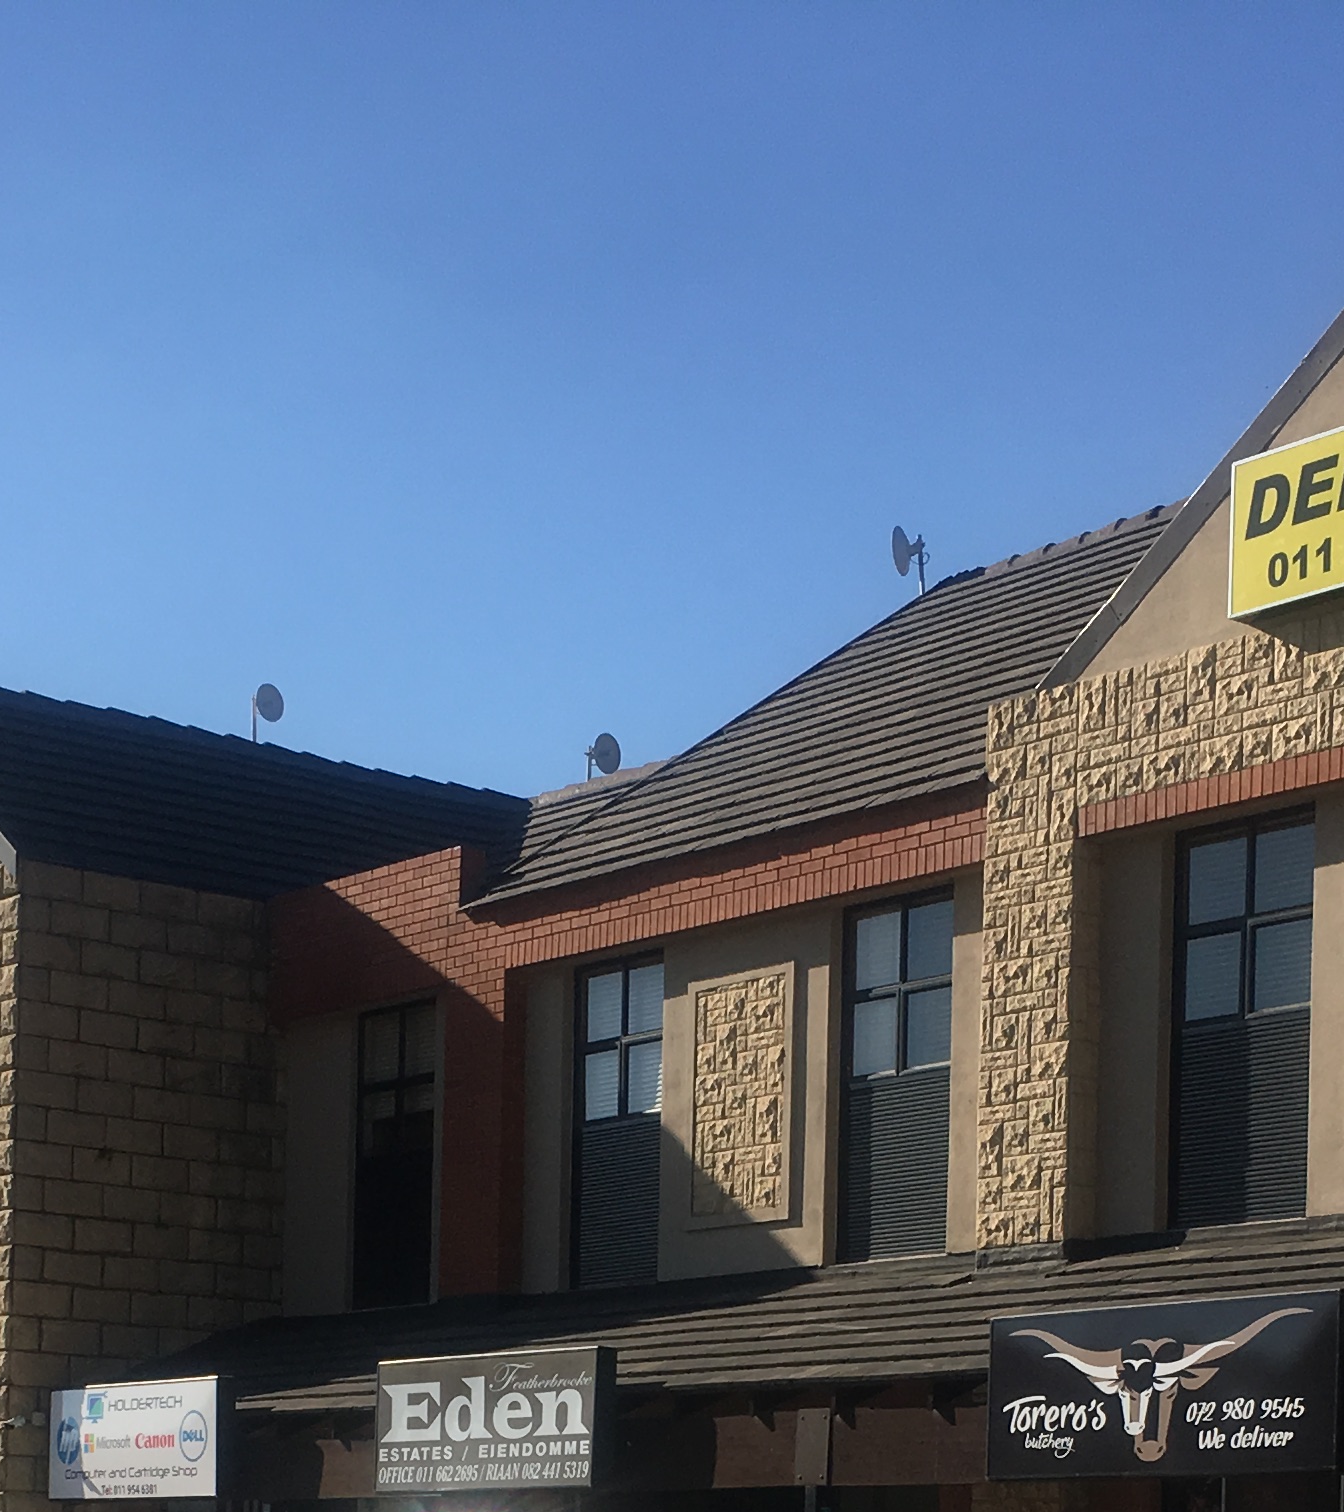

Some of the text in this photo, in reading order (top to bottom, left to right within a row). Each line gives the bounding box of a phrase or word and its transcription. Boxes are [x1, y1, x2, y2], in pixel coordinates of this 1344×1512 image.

[1268, 537, 1332, 588] 011
[489, 1362, 593, 1391] Featherbrooke
[108, 1396, 183, 1413] HOLDERTECH
[381, 1376, 590, 1443] Eden
[1002, 1395, 1107, 1434] Torero's
[1185, 1397, 1305, 1425] 072 980 9545
[96, 1434, 131, 1450] Microsoft
[135, 1432, 175, 1450] Canon
[1025, 1433, 1075, 1458] butchery
[1199, 1425, 1294, 1450] We deliver
[379, 1446, 453, 1462] ESTATES
[479, 1440, 590, 1459] EIENDOMME
[108, 1467, 127, 1479] and
[128, 1467, 170, 1480] Cartridge
[172, 1466, 198, 1478] Shop
[379, 1466, 414, 1484] OFFICE
[416, 1466, 433, 1483] 011
[436, 1465, 454, 1483] 662
[454, 1465, 478, 1482] 2695
[486, 1463, 521, 1481] RIAAN
[522, 1462, 541, 1479] 082
[542, 1461, 560, 1479] 441
[563, 1461, 590, 1479] 5319
